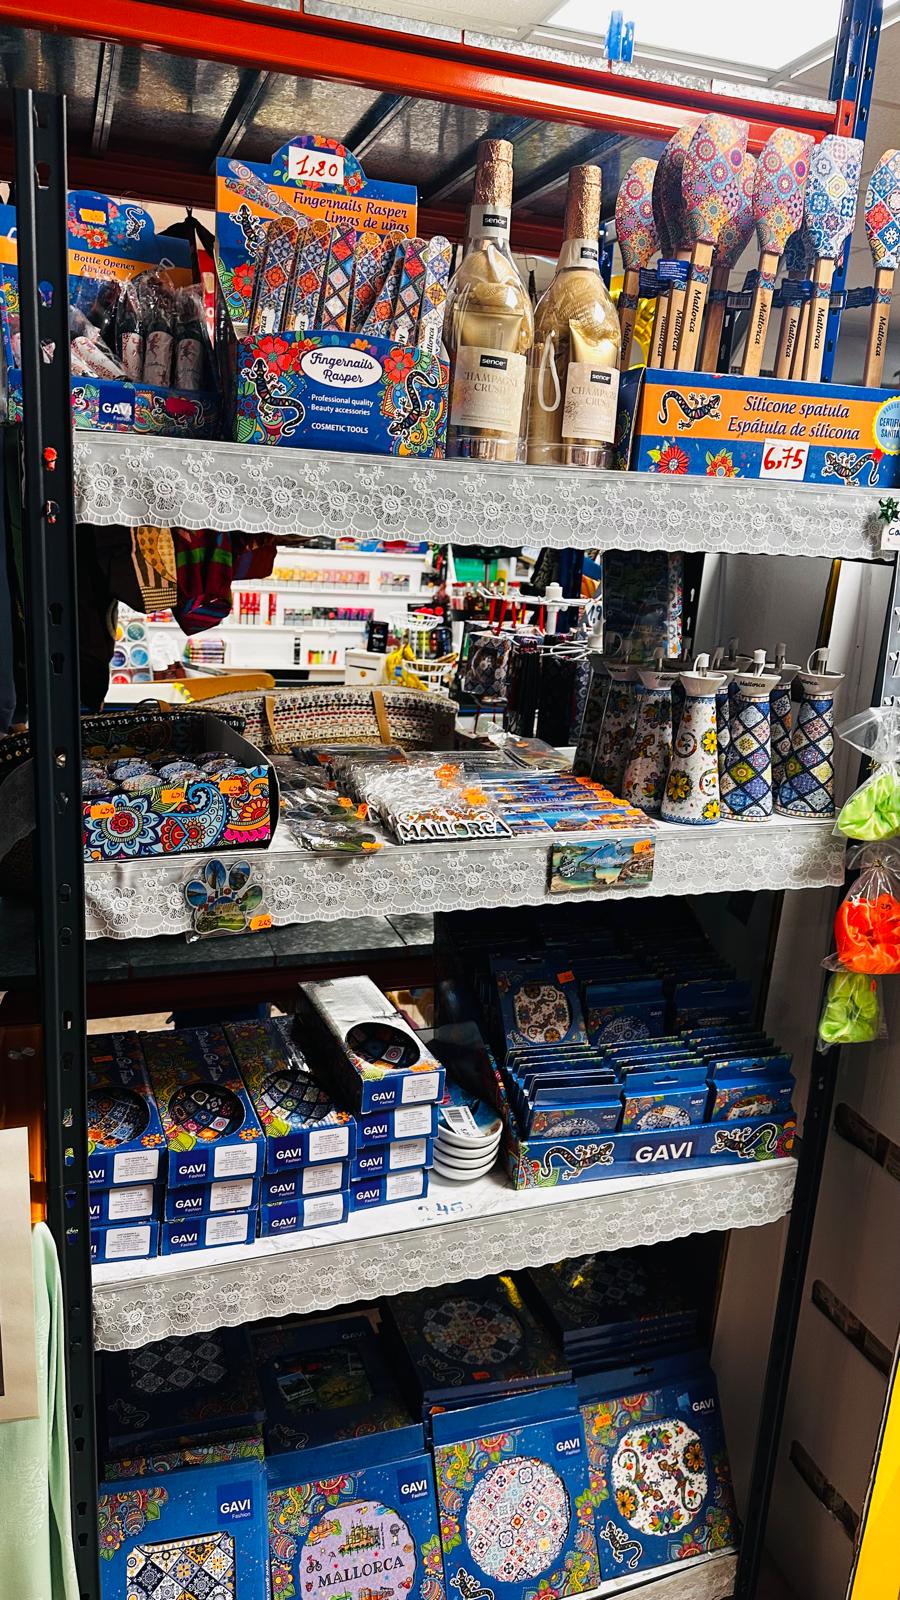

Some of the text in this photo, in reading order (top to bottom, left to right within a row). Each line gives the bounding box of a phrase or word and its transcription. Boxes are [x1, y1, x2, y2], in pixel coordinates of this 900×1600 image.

[296, 155, 338, 177] 1,20
[293, 191, 407, 219] Fingernails Rasper
[325, 210, 410, 233] Limas de uñas
[73, 253, 135, 271] Bottle Opener
[689, 289, 702, 332] Mallorca
[672, 309, 683, 352] Mallorca
[754, 302, 768, 345] Mallorca
[813, 307, 825, 350] Mallorca
[785, 318, 797, 358] Mallorca
[875, 316, 887, 357] Mallorca
[310, 352, 374, 369] Fingernails
[323, 369, 364, 384] Rasper
[311, 394, 374, 407] Professional quality
[744, 395, 850, 419] Silicone spatula
[311, 404, 370, 416] Beauty accessories
[311, 422, 369, 434] COSMETIC TOOLS
[728, 416, 860, 440] Espátula de silicona
[764, 447, 805, 470] 6,75
[399, 821, 510, 839] MALLORCA
[371, 1091, 395, 1102] GAVI
[363, 1125, 388, 1135] GAVI
[276, 1149, 302, 1159] GAVI
[635, 1142, 693, 1163] GAVI
[179, 1164, 206, 1175] GAVI
[359, 1157, 383, 1168] GAVI
[270, 1183, 295, 1193] GAVI
[356, 1189, 380, 1200] GAVI
[89, 1205, 100, 1214] VI
[175, 1198, 202, 1209] GAVI
[271, 1217, 297, 1227] GAVI
[171, 1233, 198, 1244] GAVI
[692, 1398, 714, 1412] GAVI
[556, 1438, 580, 1452] GAVI
[400, 1480, 428, 1495] GAVI
[411, 1491, 428, 1499] Fashion
[219, 1498, 251, 1514] GAVI
[231, 1511, 251, 1519] Fashion
[318, 1554, 405, 1588] MALLORCA
